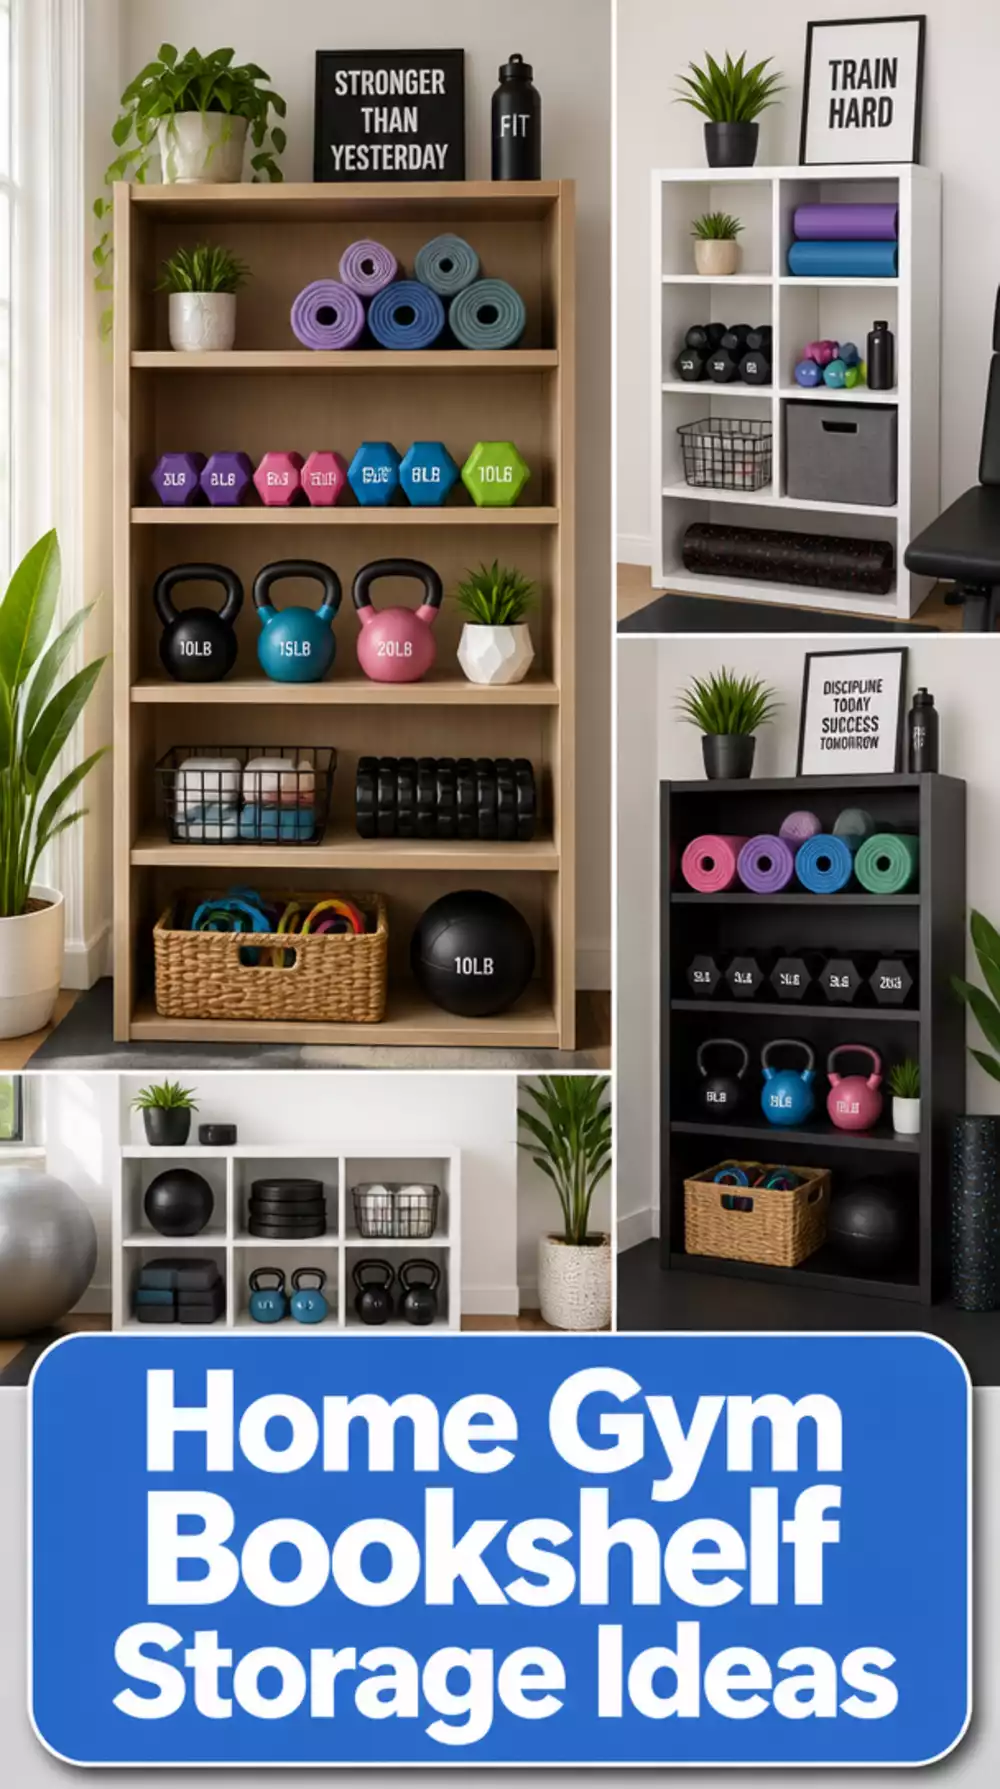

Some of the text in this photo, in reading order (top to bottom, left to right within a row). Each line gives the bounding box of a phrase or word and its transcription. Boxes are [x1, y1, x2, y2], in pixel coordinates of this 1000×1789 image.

[335, 69, 446, 96] STRONGER
[828, 57, 898, 91] TRAIN
[361, 106, 418, 133] THAN
[828, 96, 894, 129] HARD
[501, 113, 530, 138] FIT
[330, 144, 449, 171] YESTERDAY
[180, 641, 212, 657] 10LB
[377, 641, 412, 657] 20LB
[823, 679, 884, 696] DISCIPLINE
[833, 697, 871, 713] TODAY
[821, 715, 880, 734] SUCCESS
[454, 956, 495, 975] 10LB
